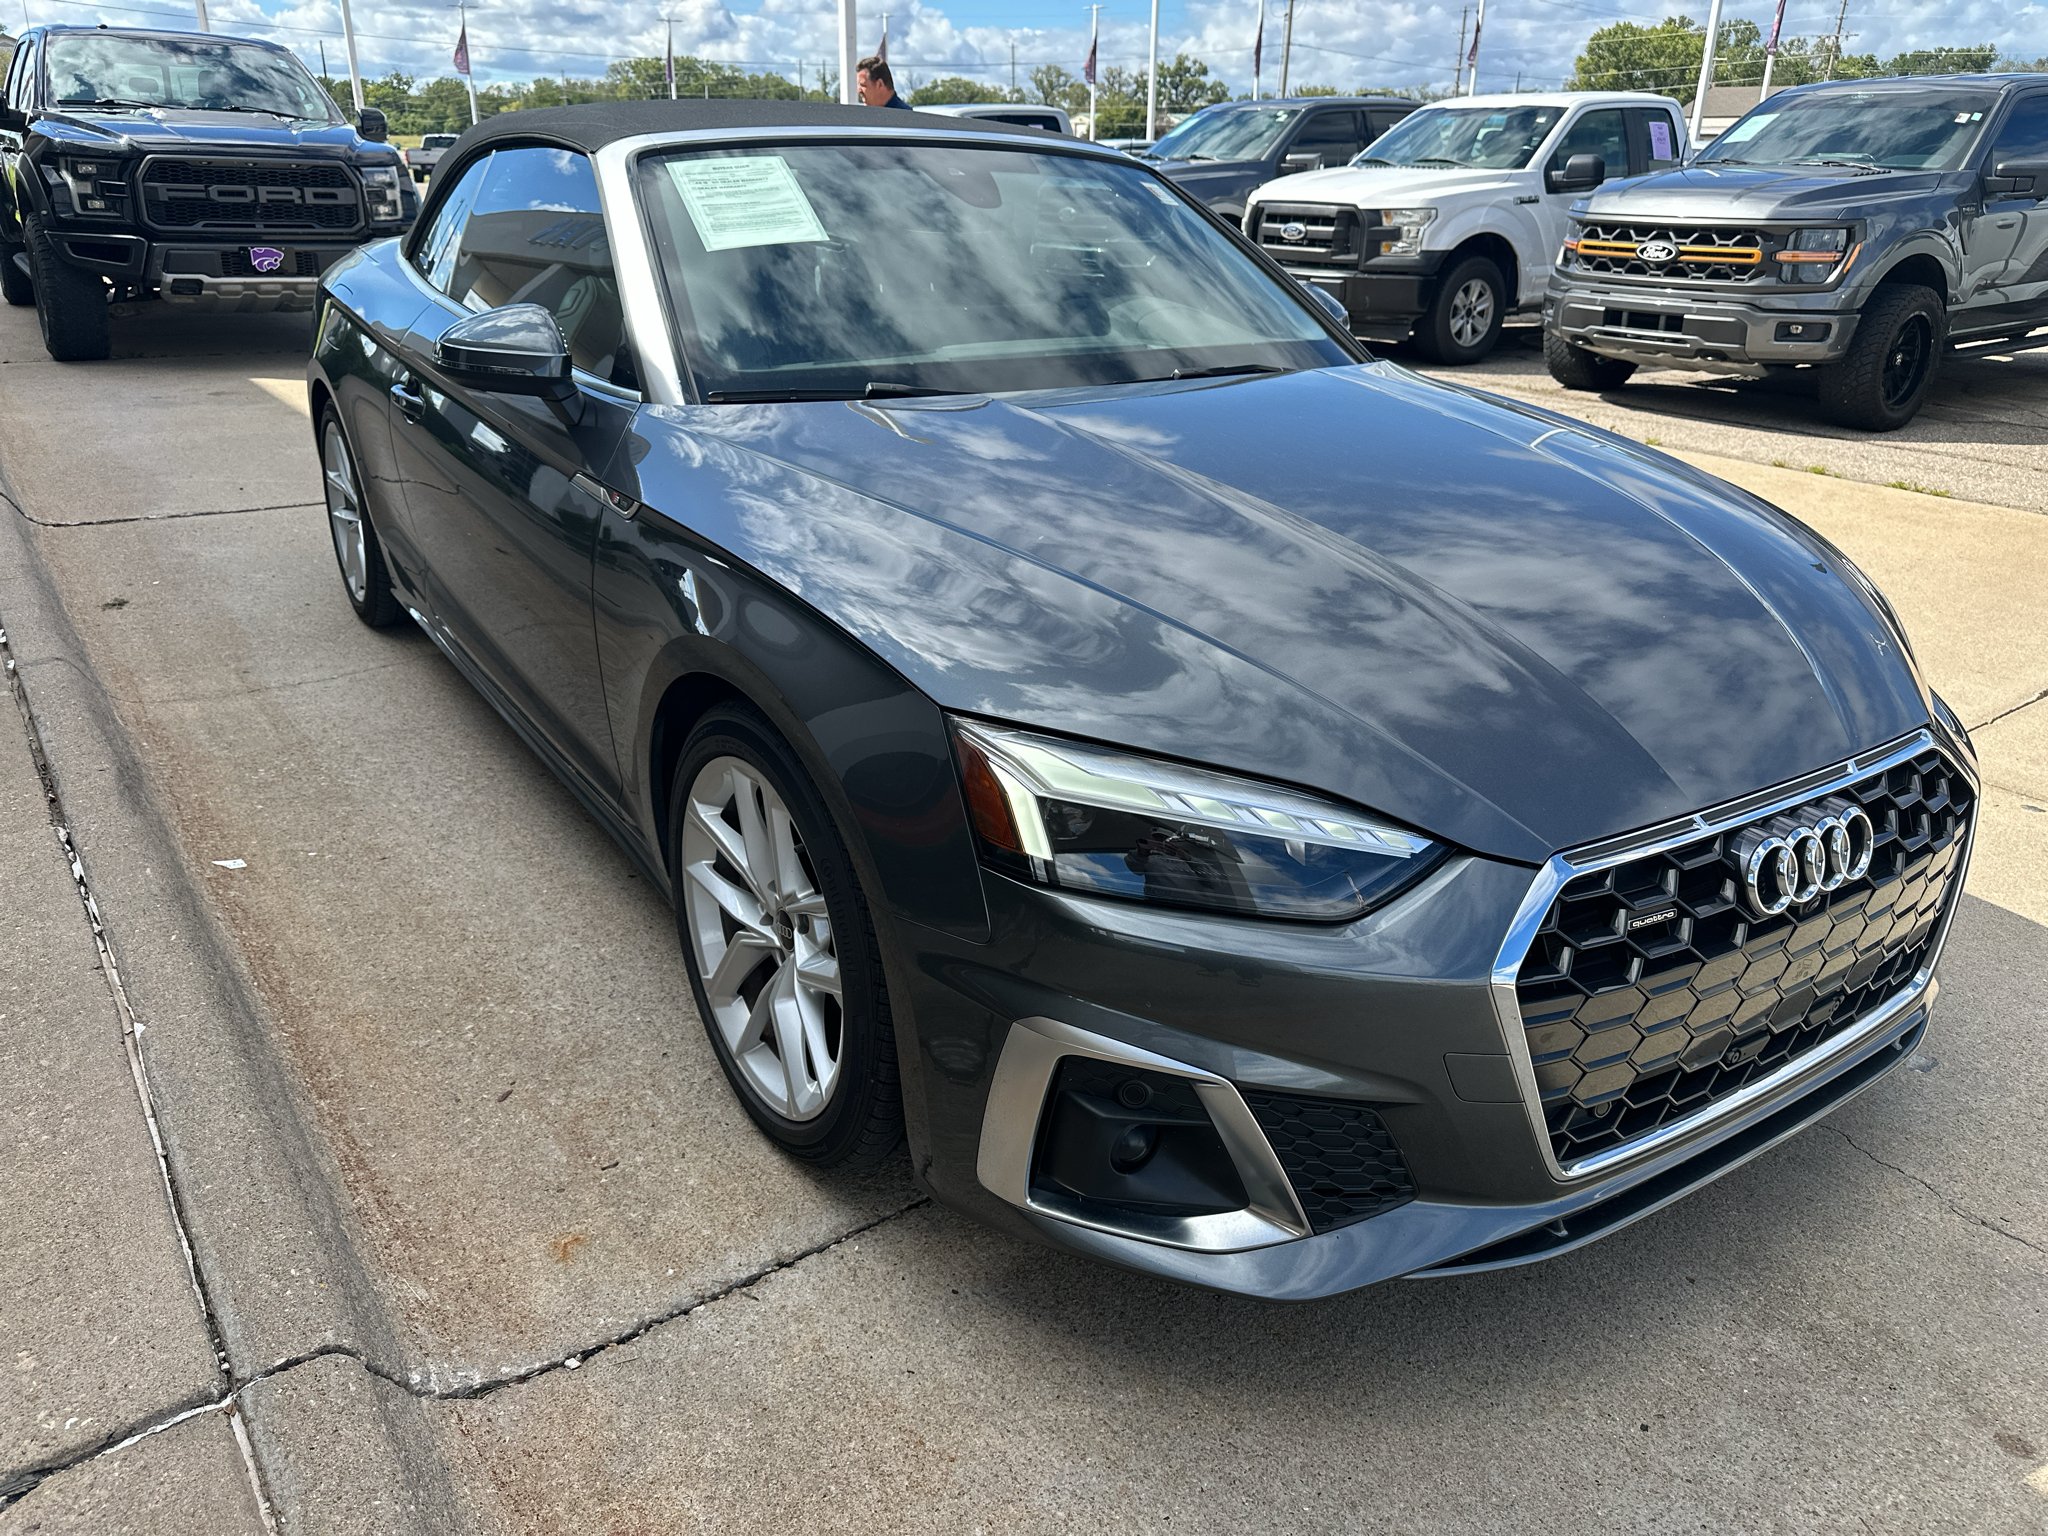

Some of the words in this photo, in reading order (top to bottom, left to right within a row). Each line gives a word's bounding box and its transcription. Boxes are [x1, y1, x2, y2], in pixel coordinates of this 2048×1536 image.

[157, 184, 352, 204] FORD
[1643, 245, 1669, 258] Ford
[1632, 911, 1675, 928] quattro
